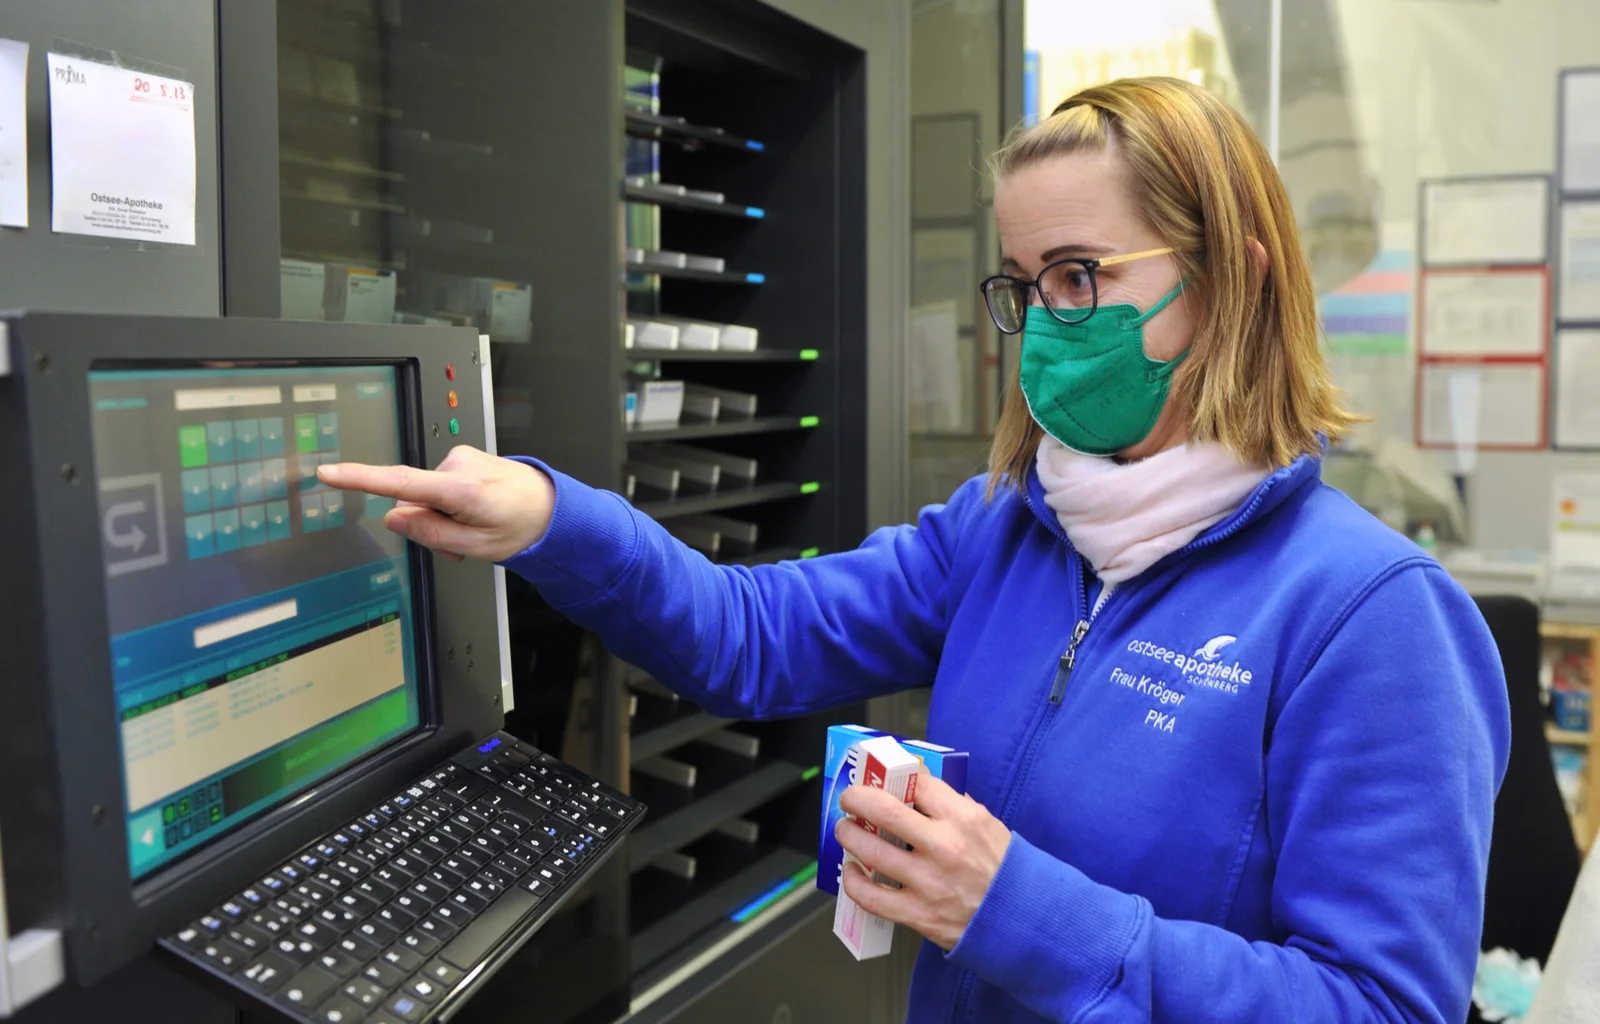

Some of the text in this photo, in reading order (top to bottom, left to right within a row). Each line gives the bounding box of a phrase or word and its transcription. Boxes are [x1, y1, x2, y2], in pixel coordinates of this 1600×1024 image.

[134, 77, 150, 93] 20
[90, 192, 163, 210] Ostsee-Apotheke
[1109, 667, 1186, 706] Frau Kröger
[1144, 709, 1176, 734] PKA
